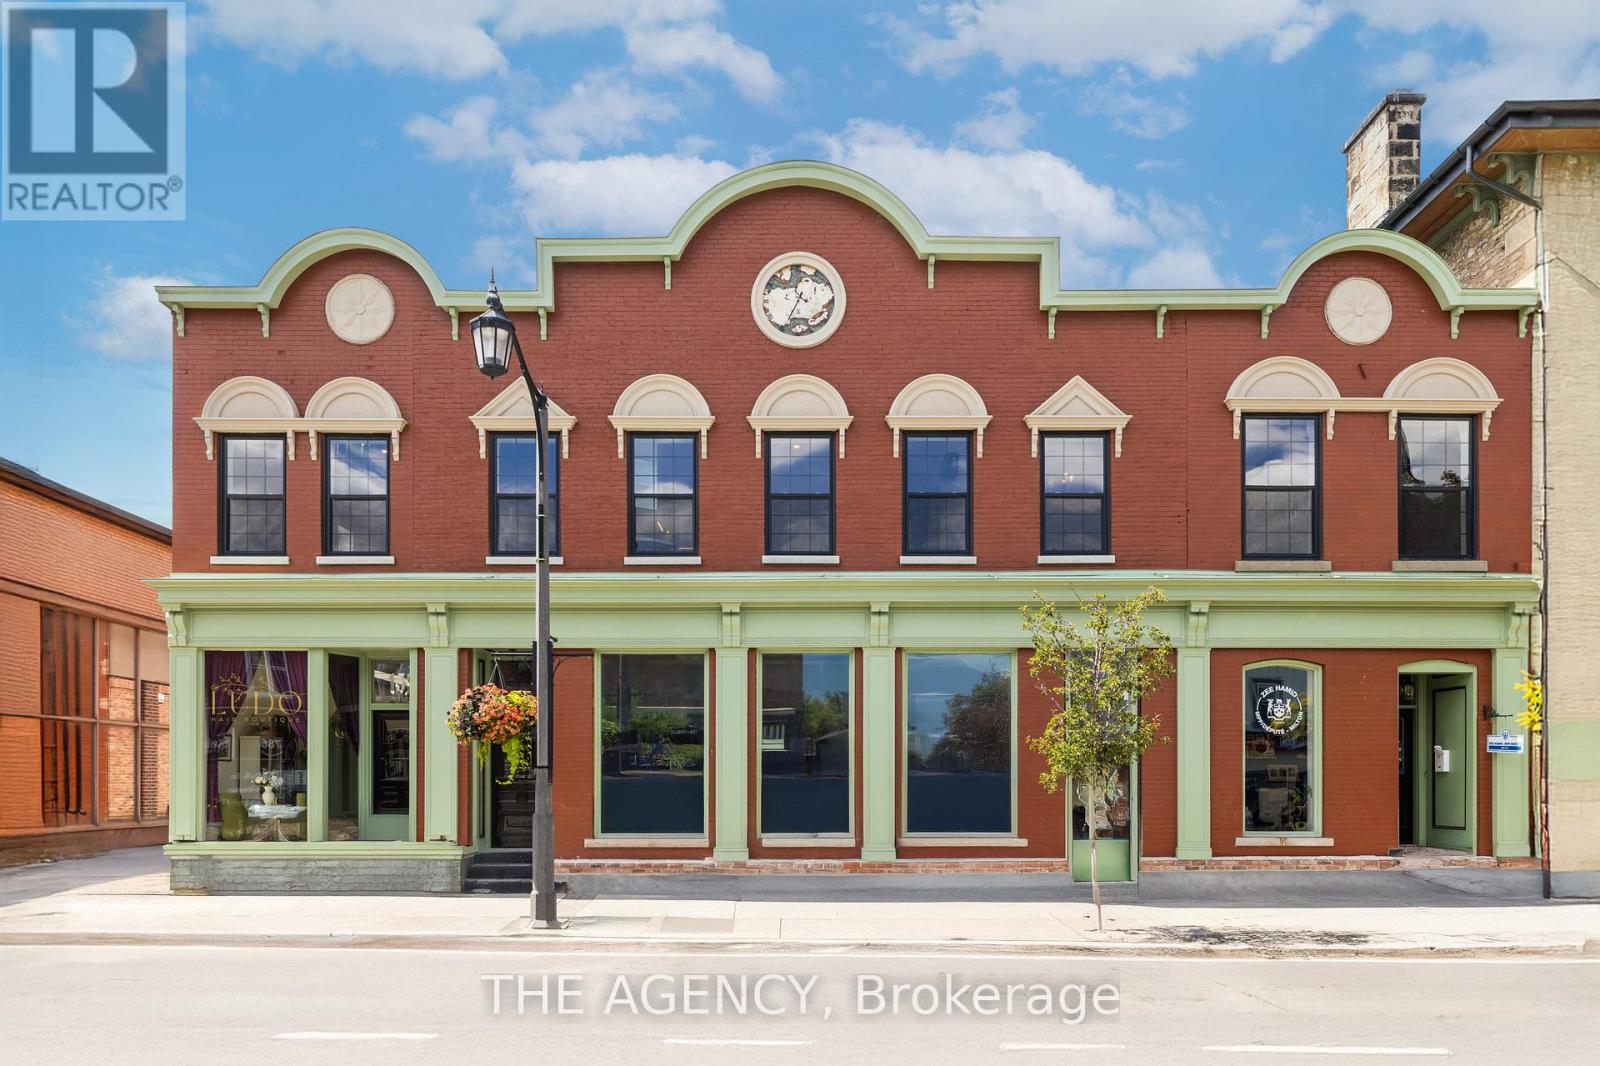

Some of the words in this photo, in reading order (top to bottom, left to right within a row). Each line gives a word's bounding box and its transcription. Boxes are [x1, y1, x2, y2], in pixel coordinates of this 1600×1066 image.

[1260, 686, 1275, 698] ZEE
[1275, 685, 1298, 698] HAMID
[211, 690, 302, 715] LUDO
[1289, 711, 1304, 732] MILTON
